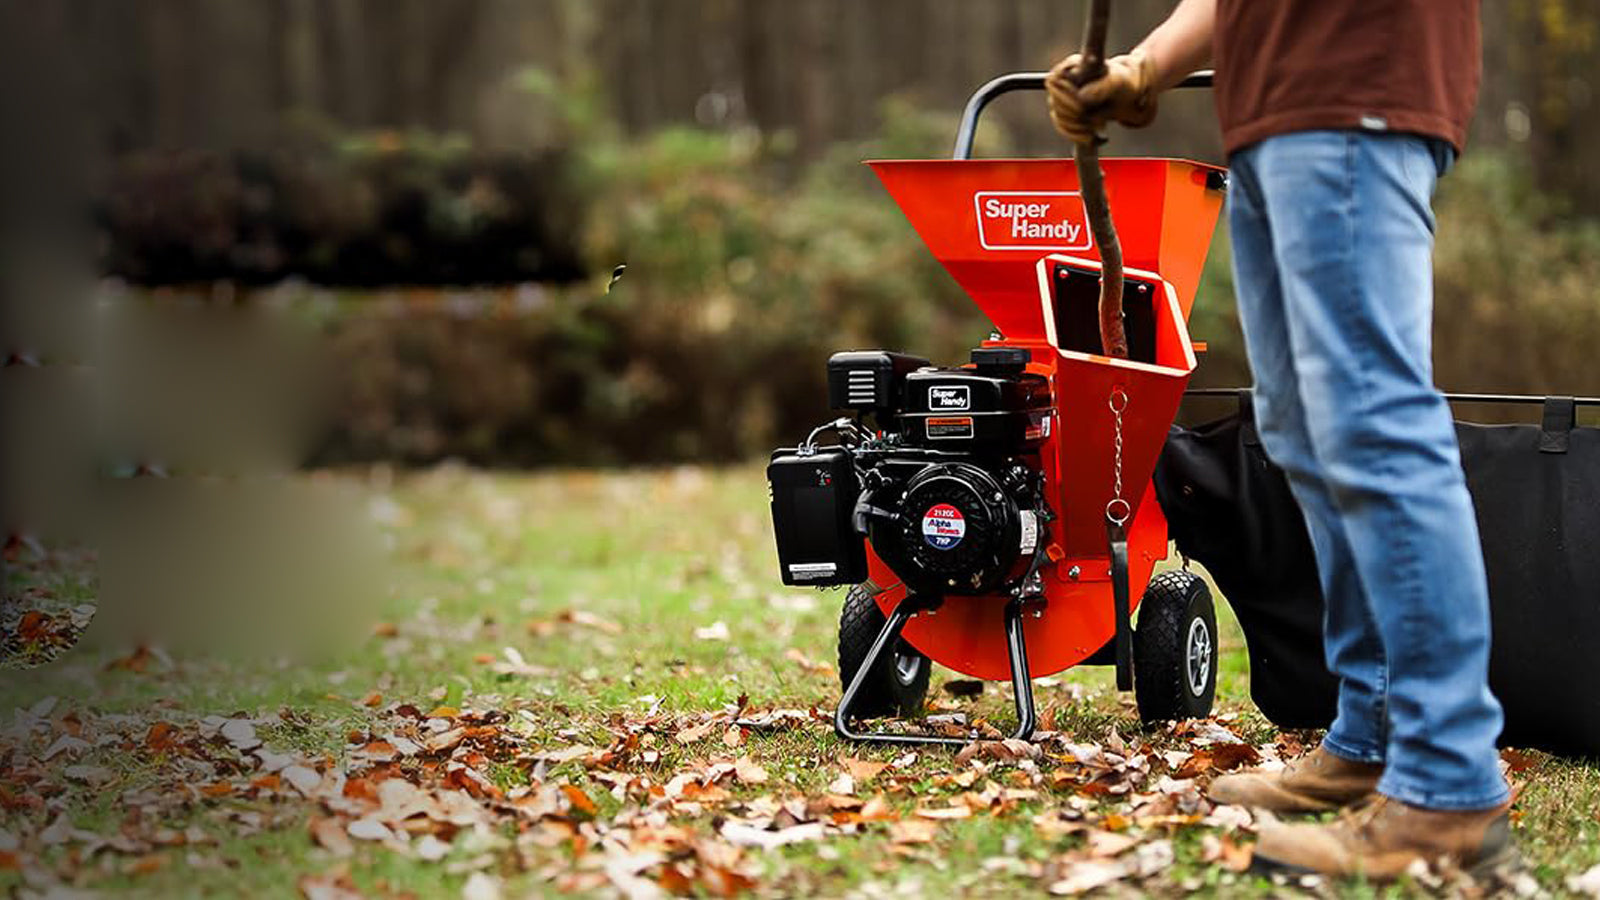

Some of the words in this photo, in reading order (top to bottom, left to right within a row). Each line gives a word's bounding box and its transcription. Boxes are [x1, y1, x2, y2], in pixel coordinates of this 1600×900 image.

[985, 199, 1050, 222] Super
[1012, 219, 1080, 243] Handy
[932, 389, 957, 398] Super
[940, 397, 966, 407] Handy
